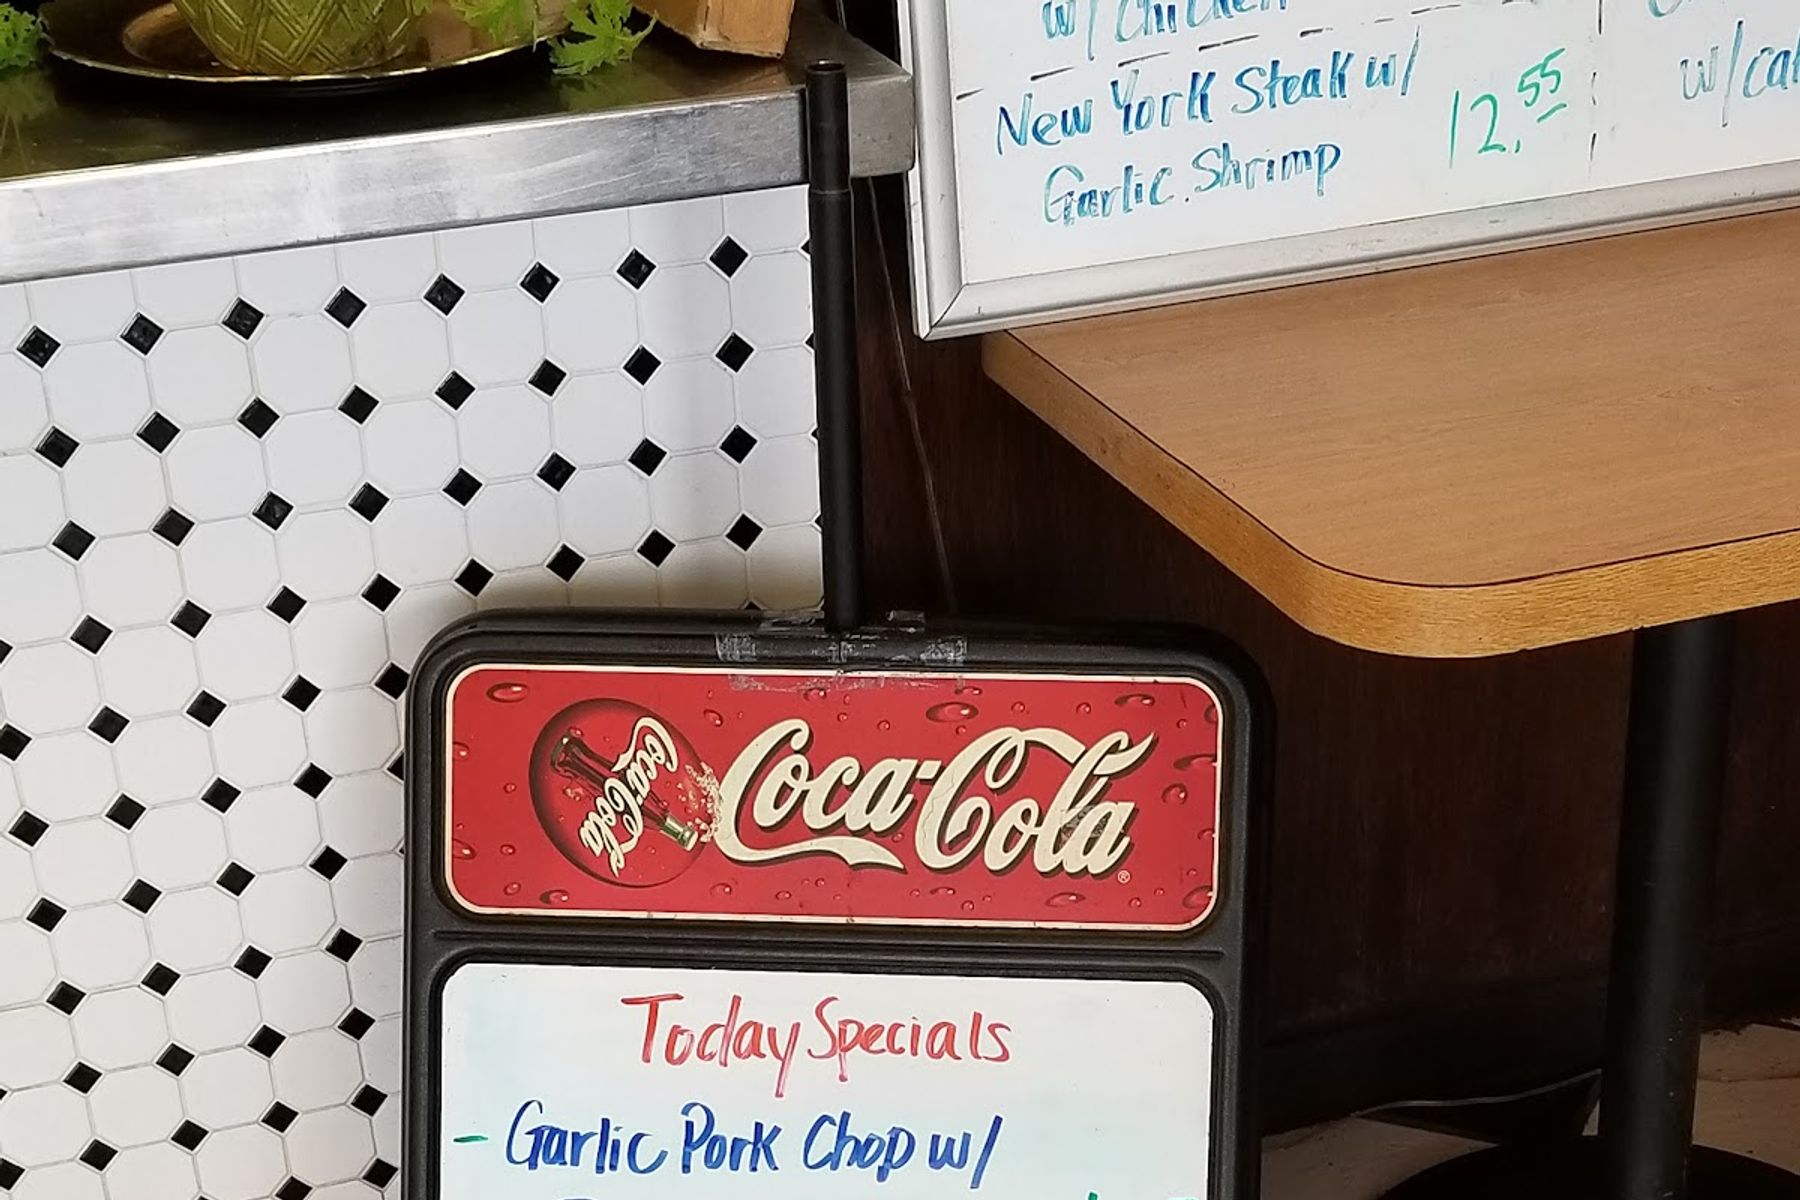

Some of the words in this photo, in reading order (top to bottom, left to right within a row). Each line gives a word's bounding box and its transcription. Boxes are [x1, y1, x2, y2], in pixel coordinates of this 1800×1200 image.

[997, 93, 1094, 154] New
[1110, 69, 1216, 135] York
[1231, 50, 1353, 115] Steak
[1365, 26, 1420, 97] w/
[1191, 142, 1342, 195] Shrimp
[580, 717, 678, 877] Coca-Cola
[713, 717, 1158, 875] Coca-Cola
[621, 993, 802, 1098] Today
[806, 995, 1011, 1082] Specials
[505, 1100, 668, 1175] Garlic
[681, 1102, 782, 1175] Pork
[802, 1111, 917, 1183] Chop
[928, 1115, 1003, 1189] w/
